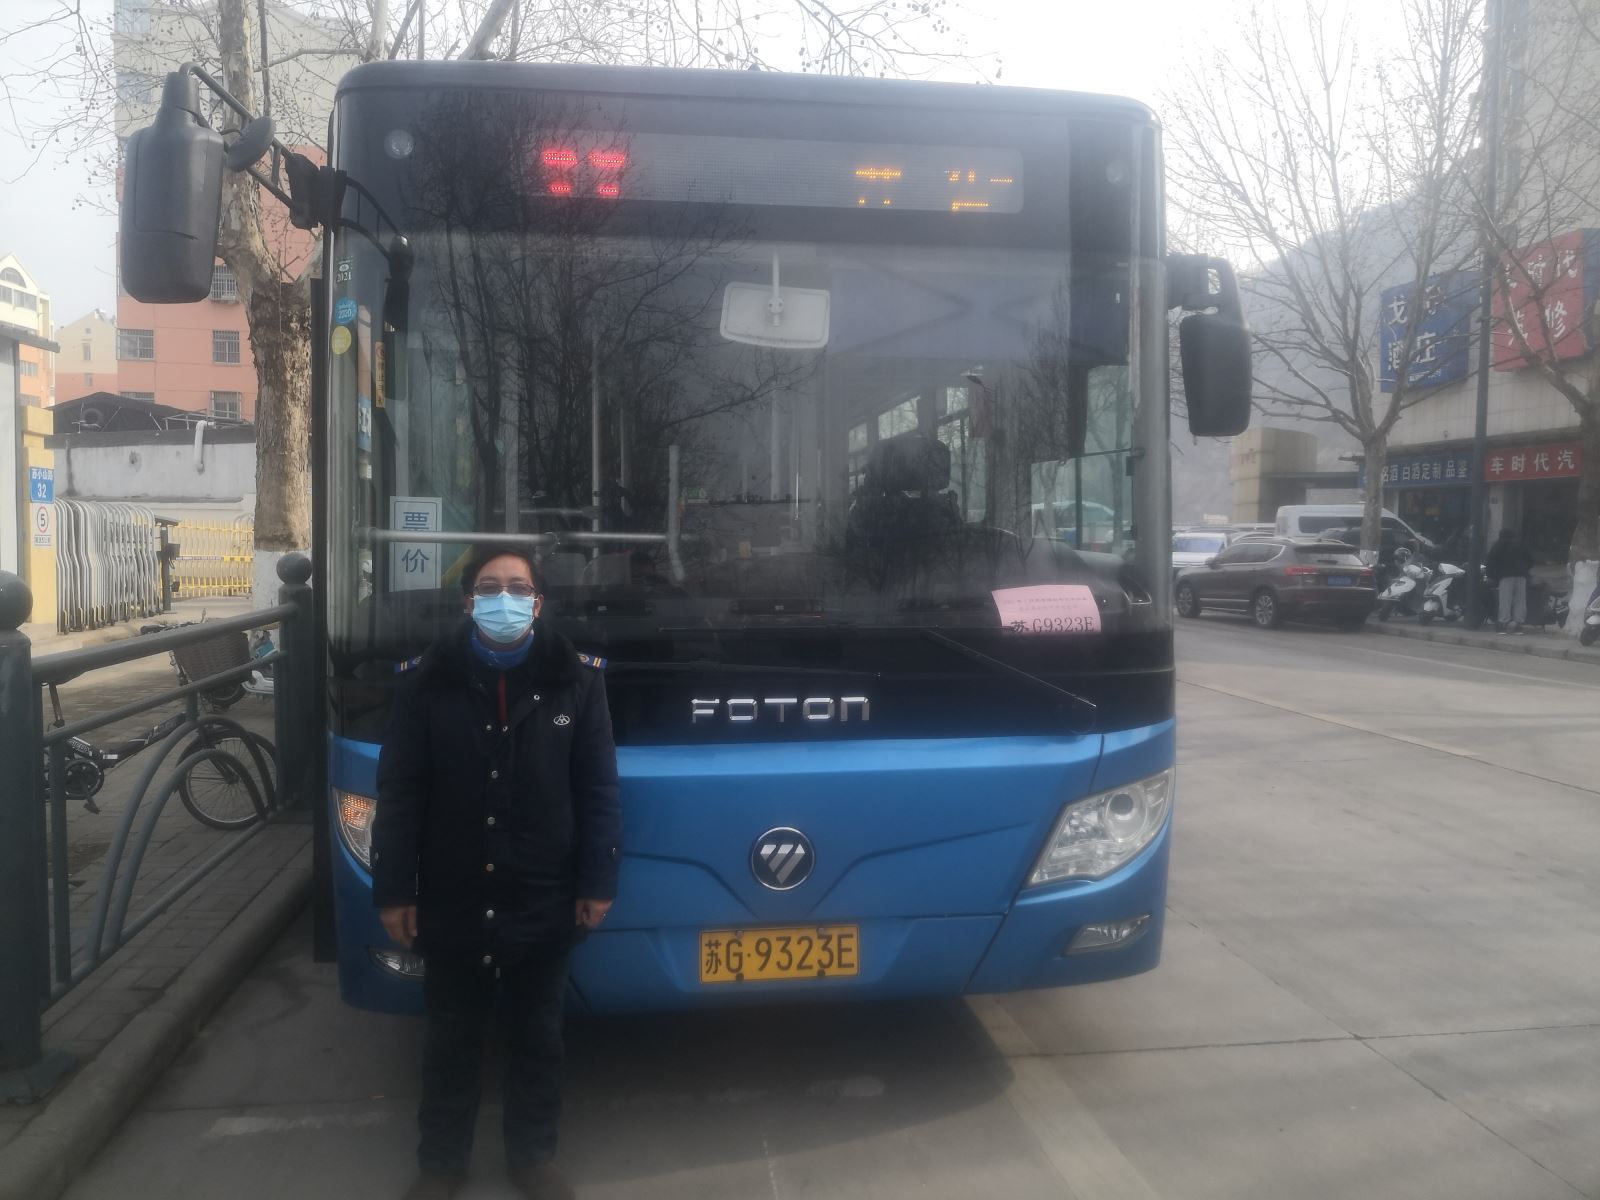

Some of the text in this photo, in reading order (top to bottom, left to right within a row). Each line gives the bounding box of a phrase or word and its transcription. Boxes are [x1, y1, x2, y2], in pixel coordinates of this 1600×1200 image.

[336, 271, 352, 282] 2021
[37, 483, 47, 499] 32
[40, 513, 46, 527] 5
[401, 511, 430, 574] 票价
[691, 696, 871, 723] FOTON
